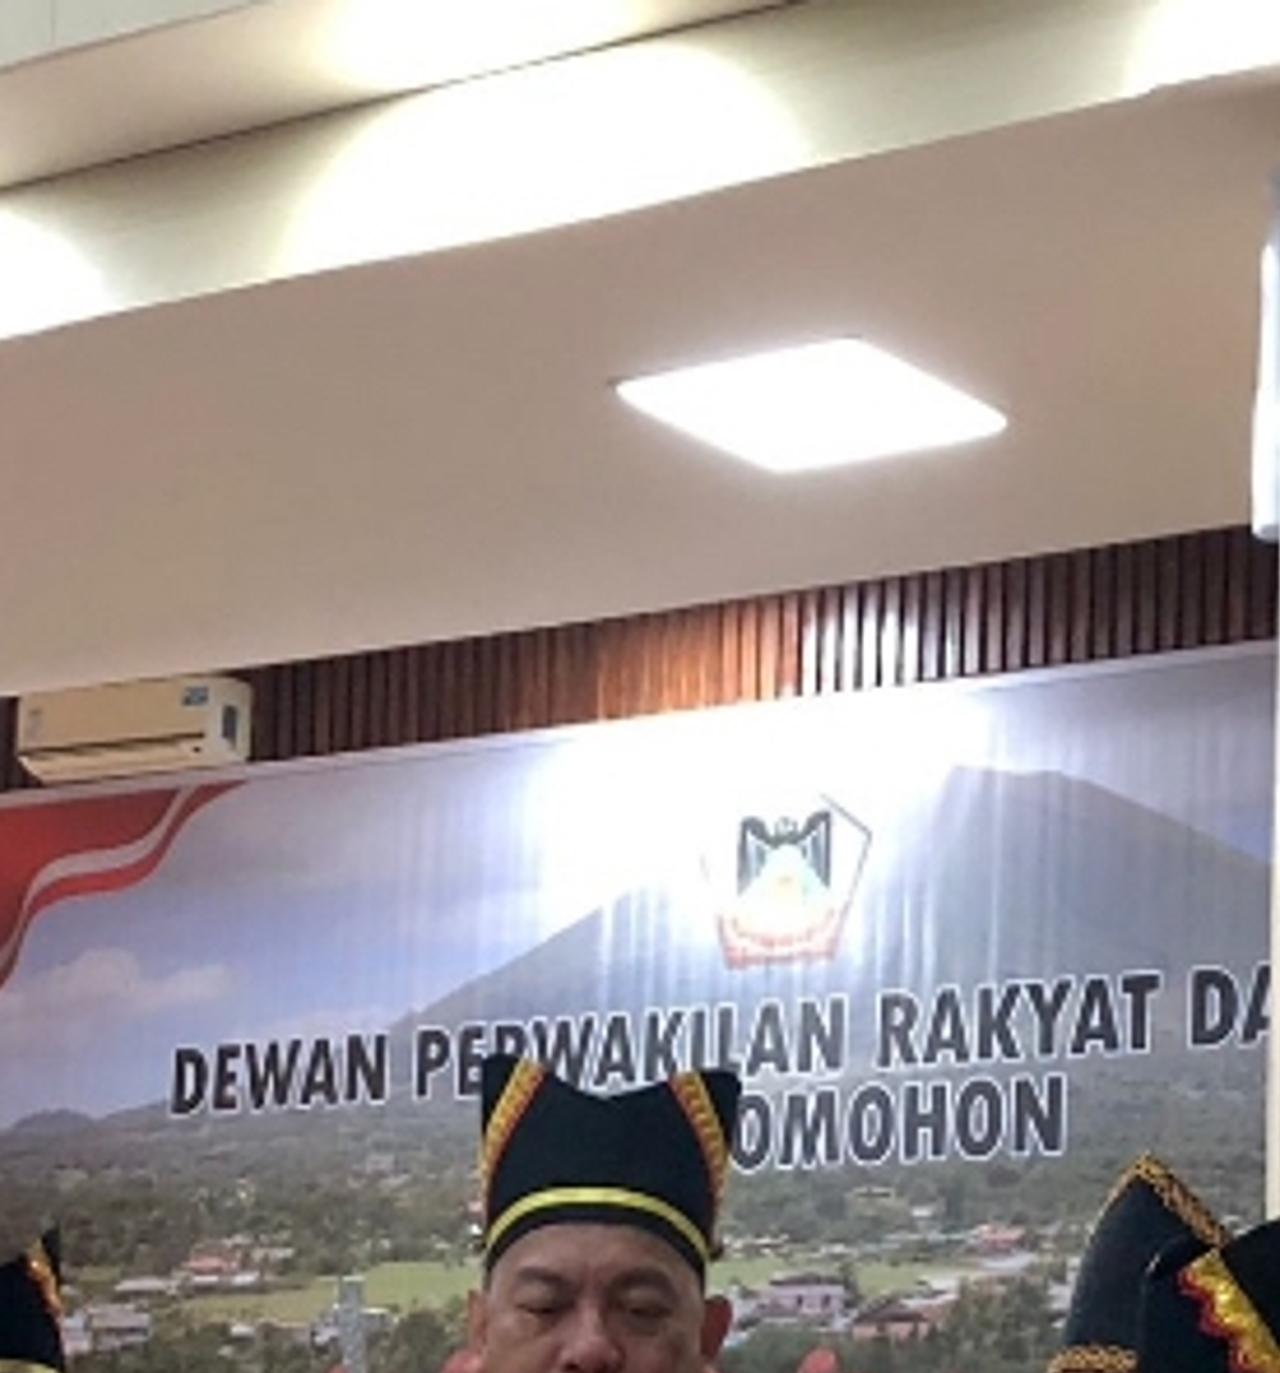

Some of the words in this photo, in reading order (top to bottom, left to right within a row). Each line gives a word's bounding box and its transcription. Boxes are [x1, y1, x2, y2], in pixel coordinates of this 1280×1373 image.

[170, 1032, 389, 1116] DEWAN
[878, 971, 1162, 1069] RAKYAT
[730, 1074, 1065, 1169] OMOHON
